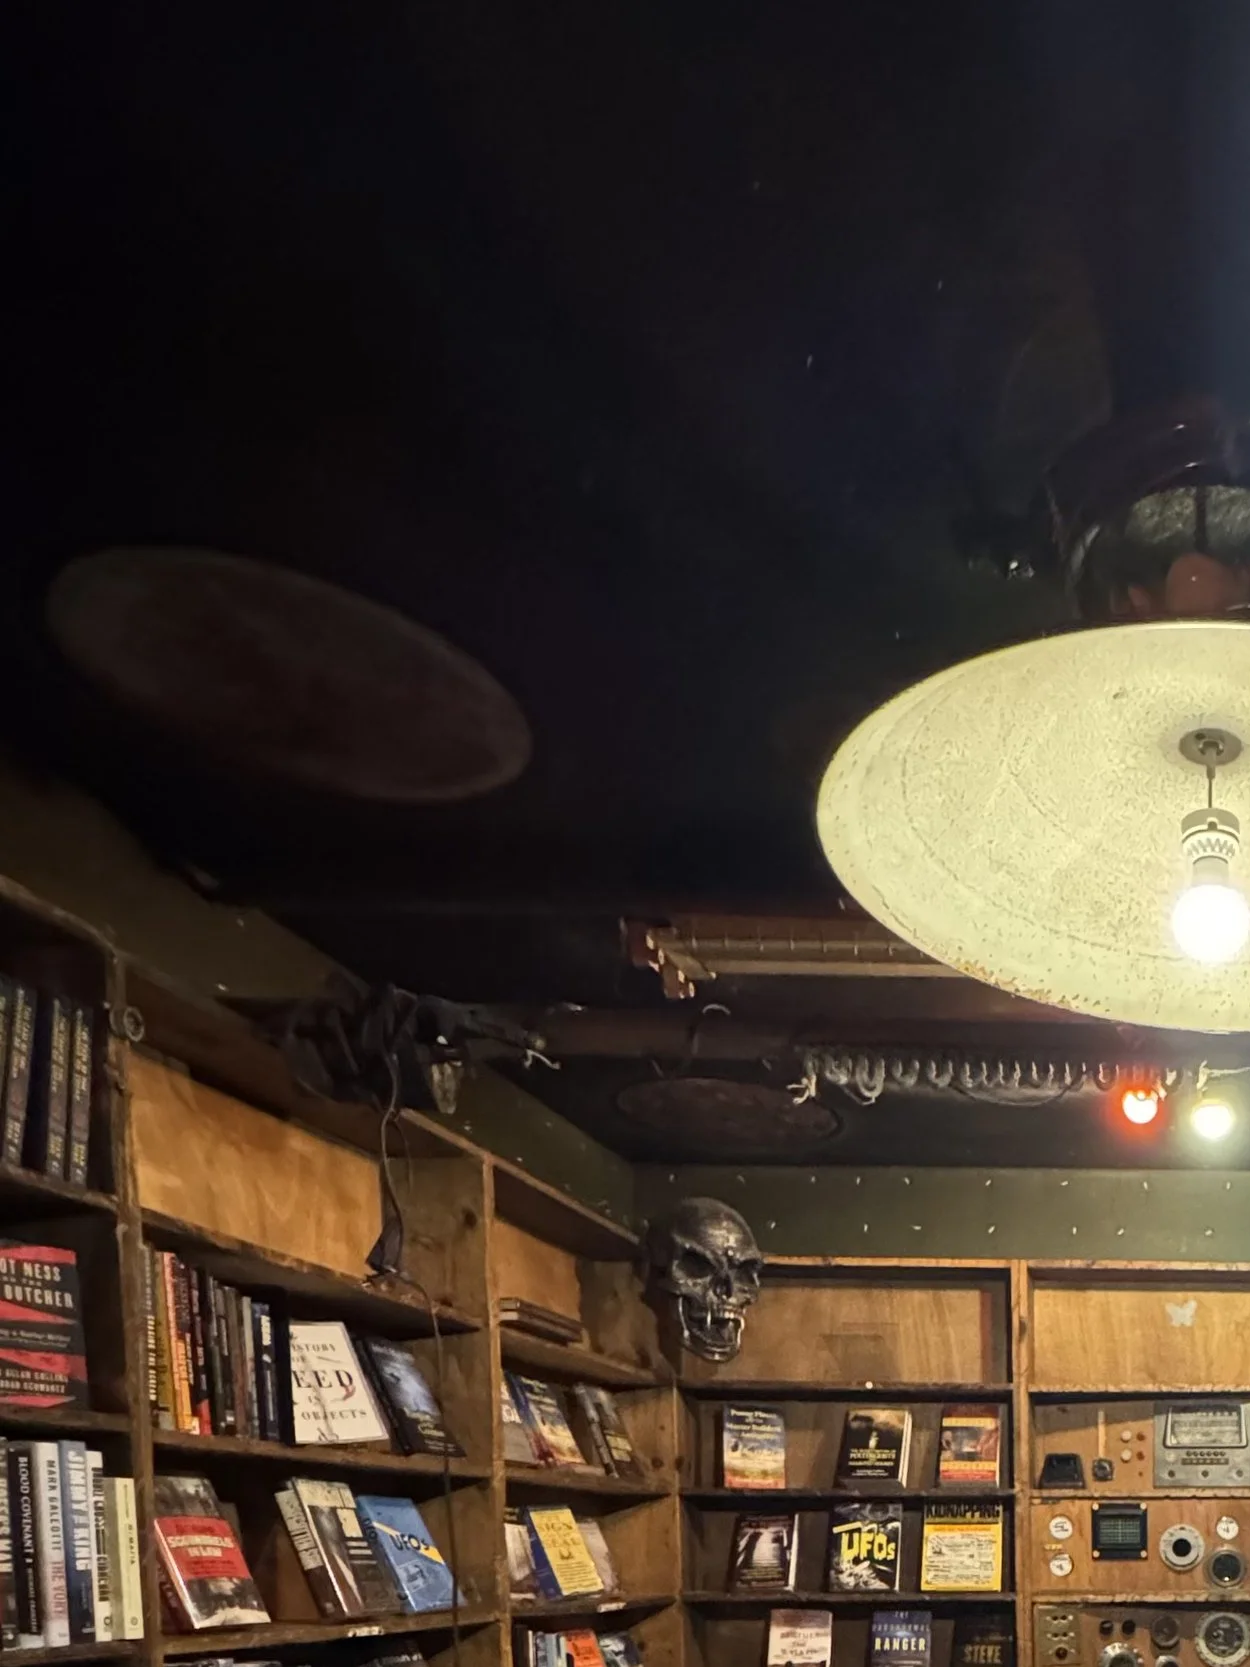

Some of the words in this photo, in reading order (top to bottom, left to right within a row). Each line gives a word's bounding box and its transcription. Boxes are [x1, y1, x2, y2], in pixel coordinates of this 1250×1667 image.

[23, 1262, 62, 1283] NESS
[4, 1284, 74, 1309] BUTCHER
[291, 1343, 336, 1353] ISTORY
[292, 1369, 354, 1389] EED
[301, 1409, 367, 1421] OBJECTS
[18, 1456, 29, 1494] BLOOD
[47, 1460, 58, 1495] MARK
[67, 1450, 88, 1515] JIMMY
[20, 1495, 35, 1553] COVENANT
[74, 1528, 92, 1571] KING
[840, 1532, 896, 1563] UFOs
[874, 1637, 926, 1651] RANGER
[963, 1644, 1003, 1664] STEVE
